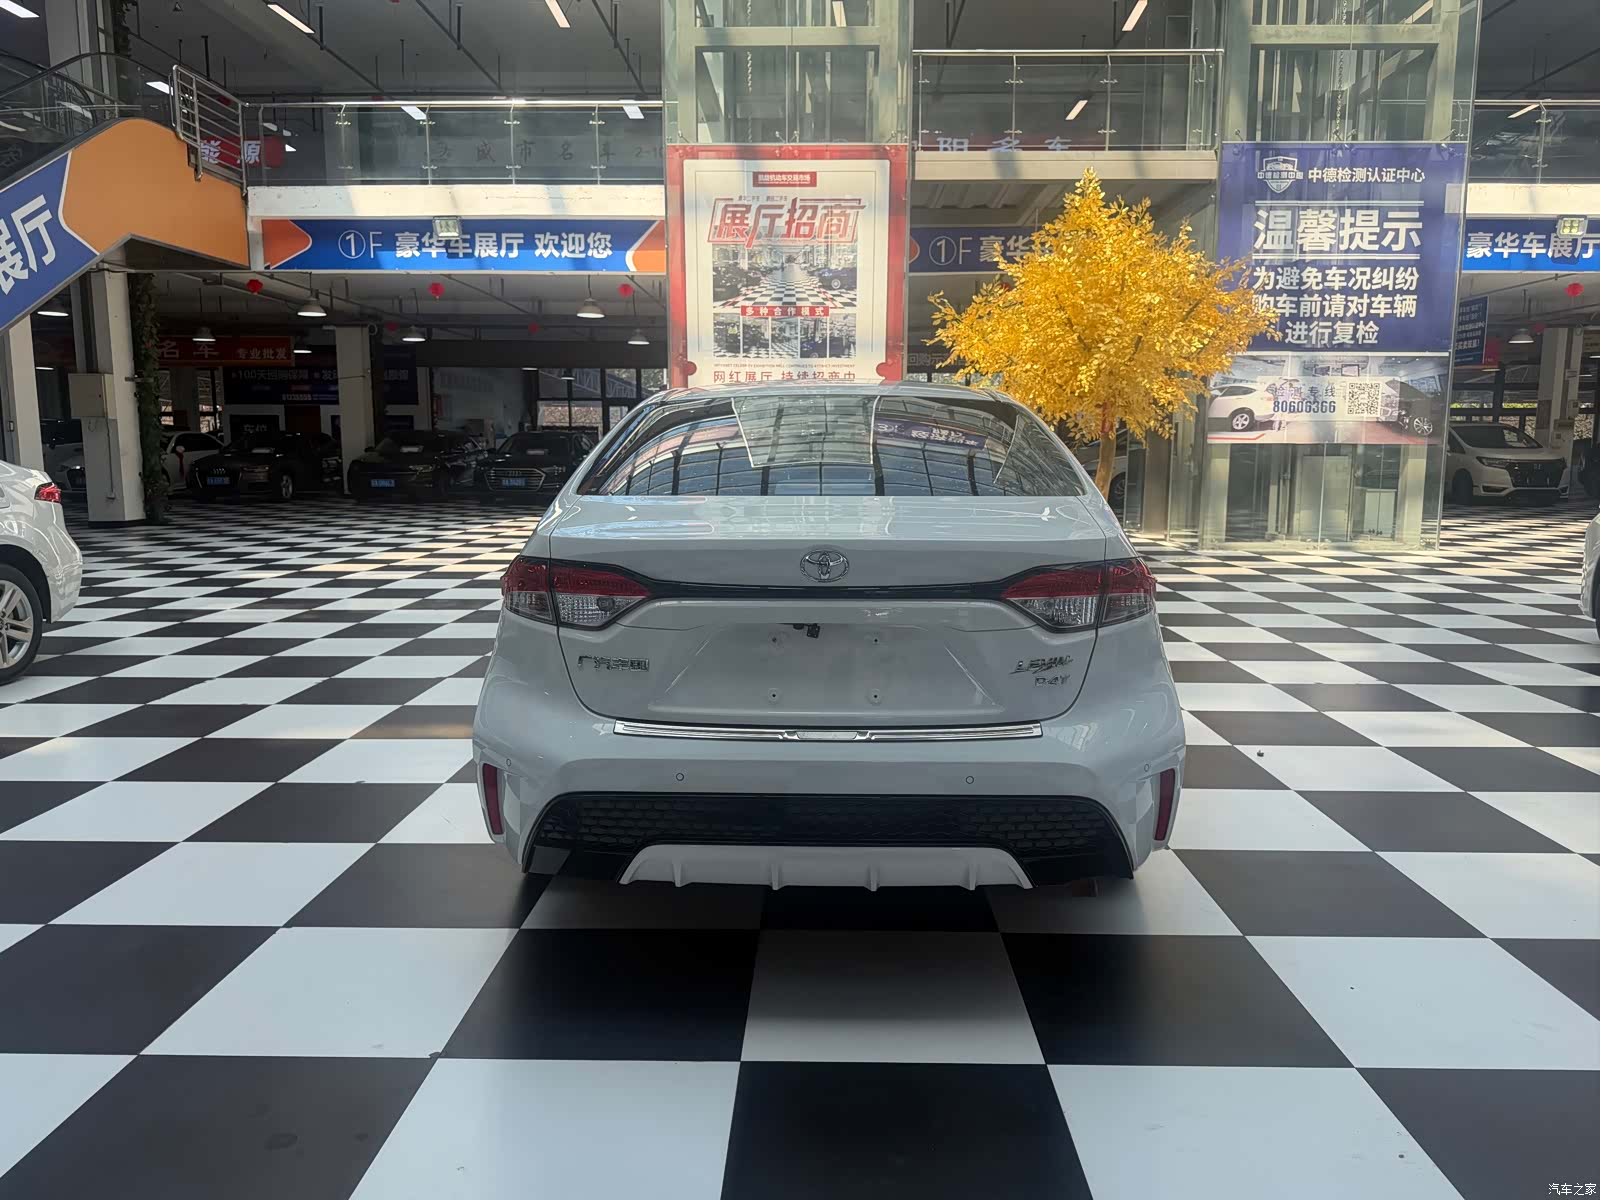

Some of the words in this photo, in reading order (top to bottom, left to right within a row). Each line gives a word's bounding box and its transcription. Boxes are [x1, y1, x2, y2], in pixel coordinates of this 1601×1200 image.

[1308, 167, 1426, 183] 中德检测认证中心
[716, 197, 866, 248] 展厅招商
[1252, 208, 1423, 252] 温馨提示
[395, 231, 526, 259] 豪华车展厅
[535, 231, 613, 259] 欢迎您
[979, 235, 1053, 262] 豪华
[1466, 231, 1600, 259] 豪华车展厅
[1252, 266, 1420, 292] 为避免车况纠纷
[745, 306, 825, 317] 多种合作模式
[1251, 294, 1417, 318] 购车前请对车辆
[1285, 321, 1380, 345] 进行复检
[160, 340, 221, 359] 名车
[236, 347, 288, 360] 专业批发
[713, 370, 773, 383] 网红展厅
[1272, 386, 1336, 400] 检测专线
[1272, 401, 1336, 413] 80606366
